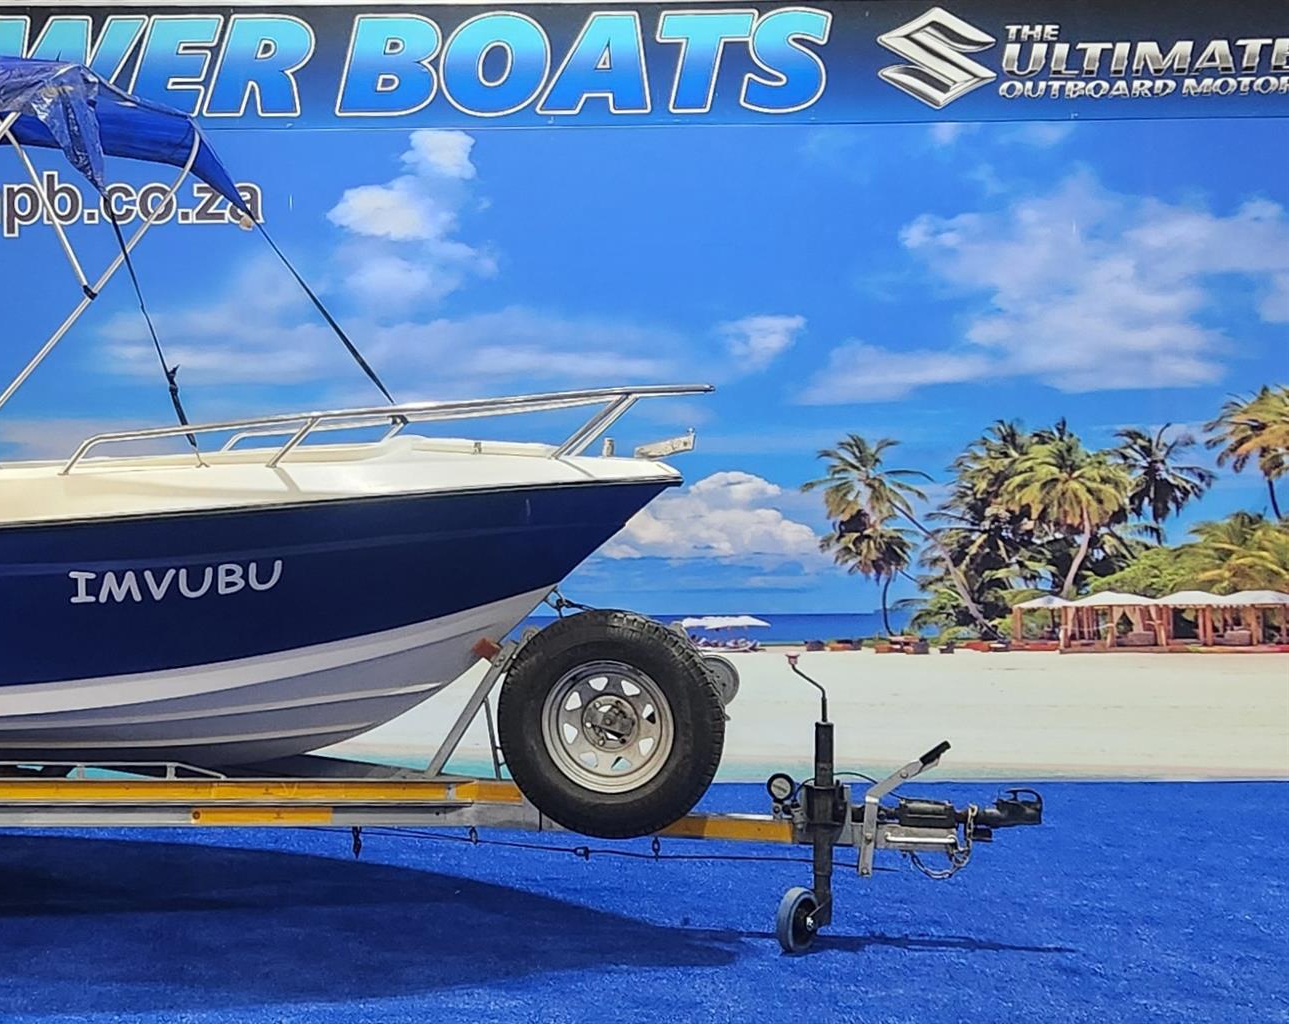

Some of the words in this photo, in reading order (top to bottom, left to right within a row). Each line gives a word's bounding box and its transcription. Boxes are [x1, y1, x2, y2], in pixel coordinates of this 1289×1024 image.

[1005, 24, 1060, 41] THE
[335, 7, 834, 116] BOATS
[999, 79, 1175, 99] OUTBOARD
[68, 559, 283, 604] IMVUBU
